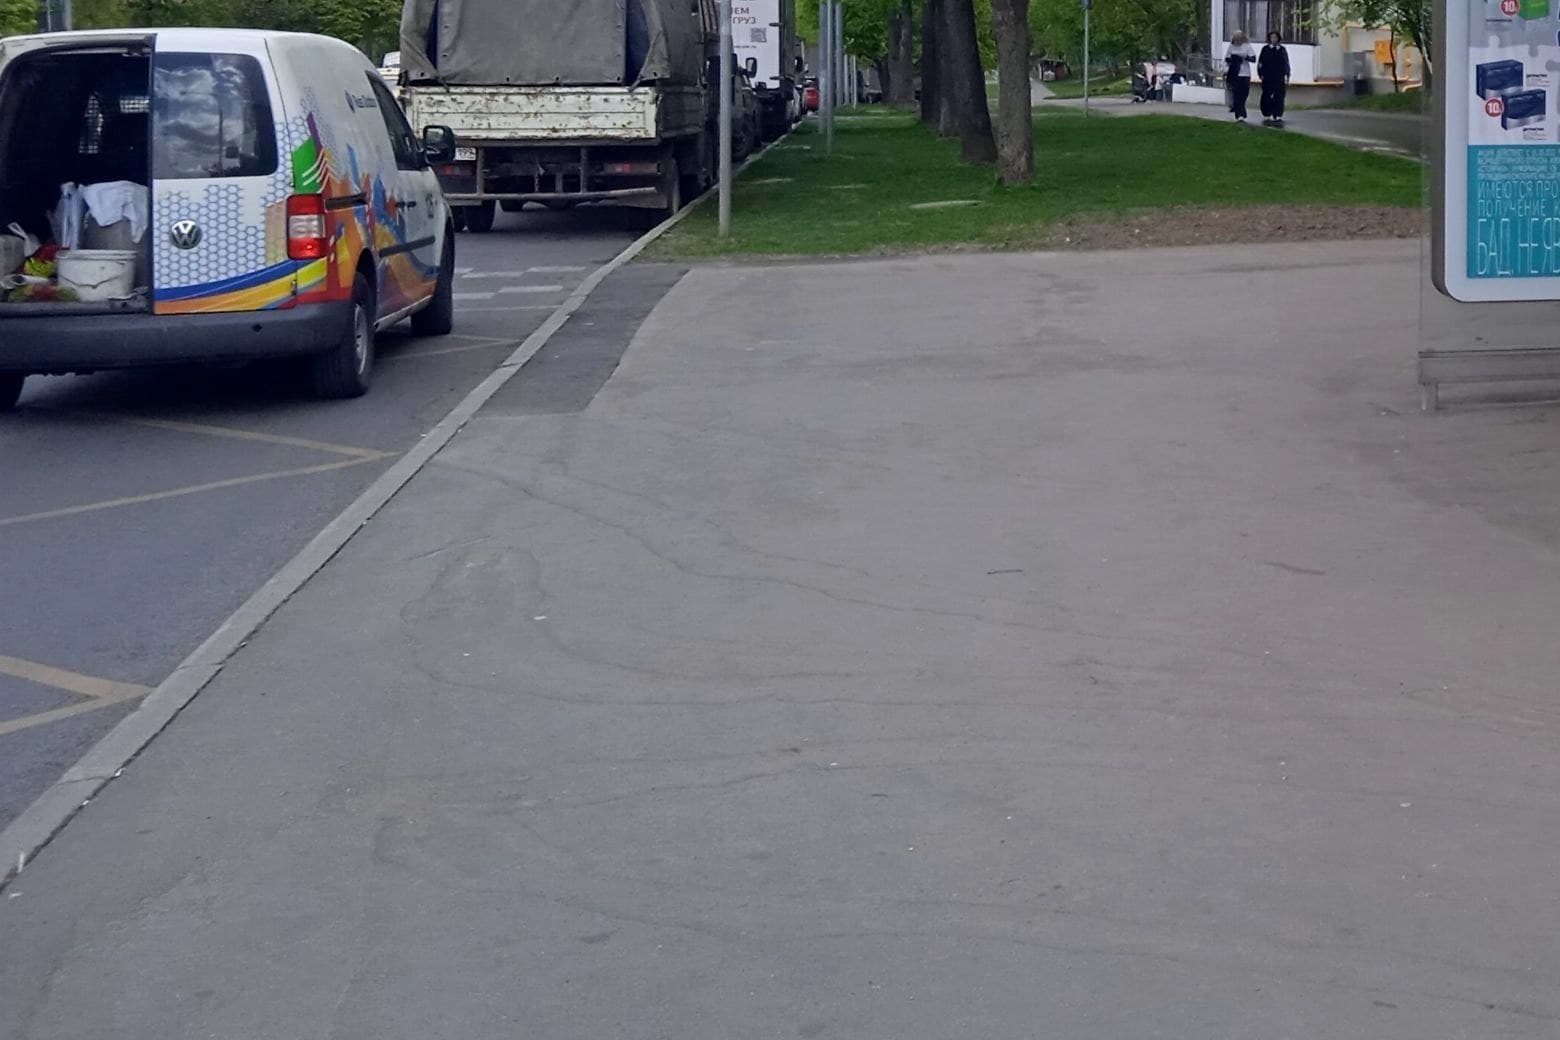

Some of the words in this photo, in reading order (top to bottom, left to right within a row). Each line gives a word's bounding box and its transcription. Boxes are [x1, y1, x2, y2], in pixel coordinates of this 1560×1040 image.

[1478, 180, 1533, 199] ИМЕЮТСЯ
[1478, 199, 1546, 217] ПОЛУЧЕНИЕ
[1518, 217, 1539, 274] НЕ
